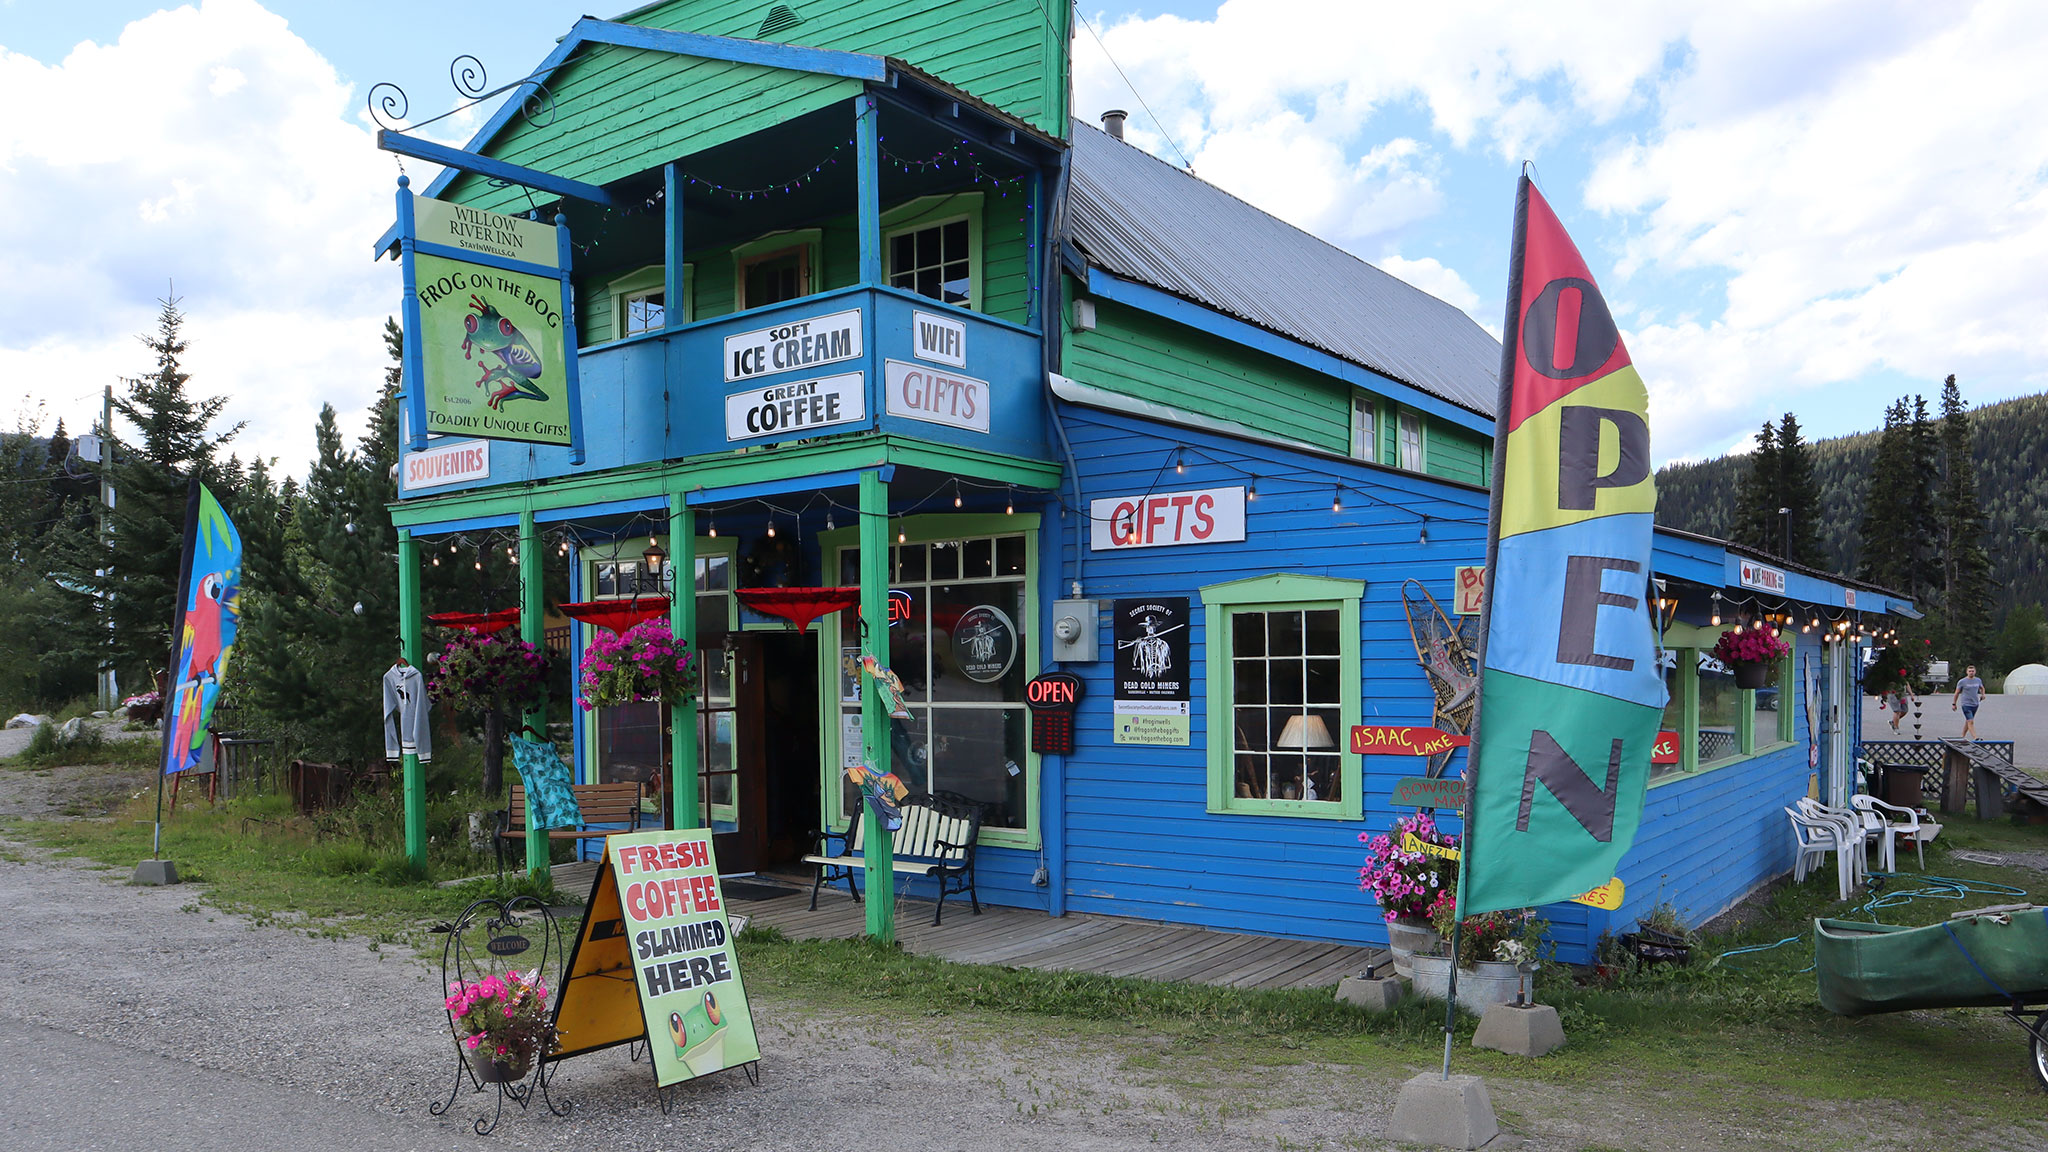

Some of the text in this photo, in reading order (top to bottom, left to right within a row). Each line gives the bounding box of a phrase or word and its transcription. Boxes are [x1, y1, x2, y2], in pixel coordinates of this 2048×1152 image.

[450, 220, 523, 248] RIVER INN
[454, 206, 517, 232] WILLOW
[419, 272, 561, 329] FROG ON THE BOG
[769, 322, 810, 343] SOFT
[920, 321, 961, 358] WIFI
[733, 327, 851, 377] ICE CREAM
[763, 382, 818, 402] GREAT
[902, 371, 977, 420] GIFTS
[428, 410, 568, 436] TOADILY UNIQUE GIFTS!
[746, 392, 841, 434] COFFEE
[409, 447, 483, 482] SOUVENIRS
[1110, 494, 1215, 546] GIFTS
[1515, 277, 1650, 843] OPEN
[1027, 680, 1075, 704] OPEN
[1123, 681, 1139, 690] DEAD
[1157, 681, 1180, 691] MINERS
[1355, 727, 1453, 756] ISAAC LAKE
[1651, 741, 1675, 759] KE
[618, 841, 710, 875] FRESH
[626, 875, 721, 922] COFFEE
[490, 940, 528, 951] WELCOME
[635, 919, 727, 961] SLAMMED
[643, 952, 733, 998] HERE
